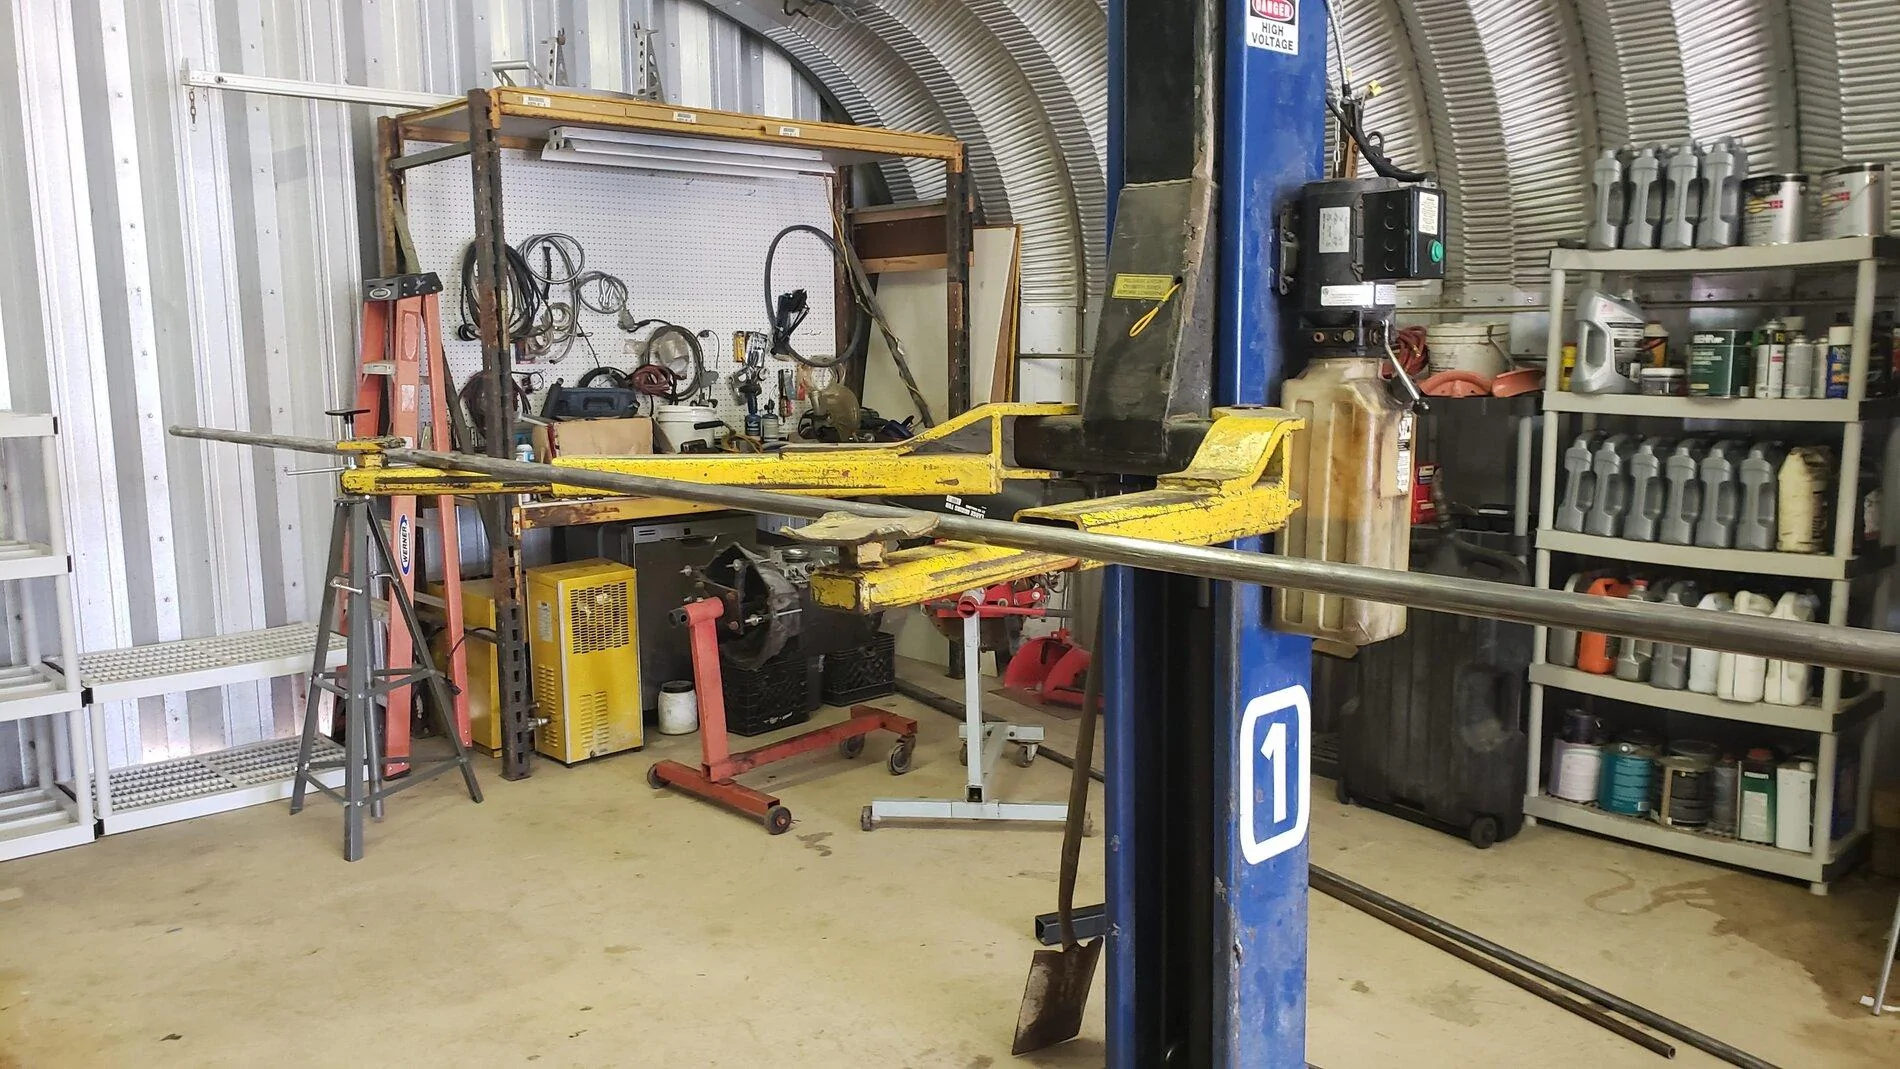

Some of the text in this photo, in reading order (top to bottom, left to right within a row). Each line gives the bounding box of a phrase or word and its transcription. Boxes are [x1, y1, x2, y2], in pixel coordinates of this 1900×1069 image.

[1255, 0, 1290, 17] DANGER
[1261, 22, 1284, 36] HIGH
[1251, 32, 1294, 51] VOLTAGE
[1260, 722, 1287, 824] 1
